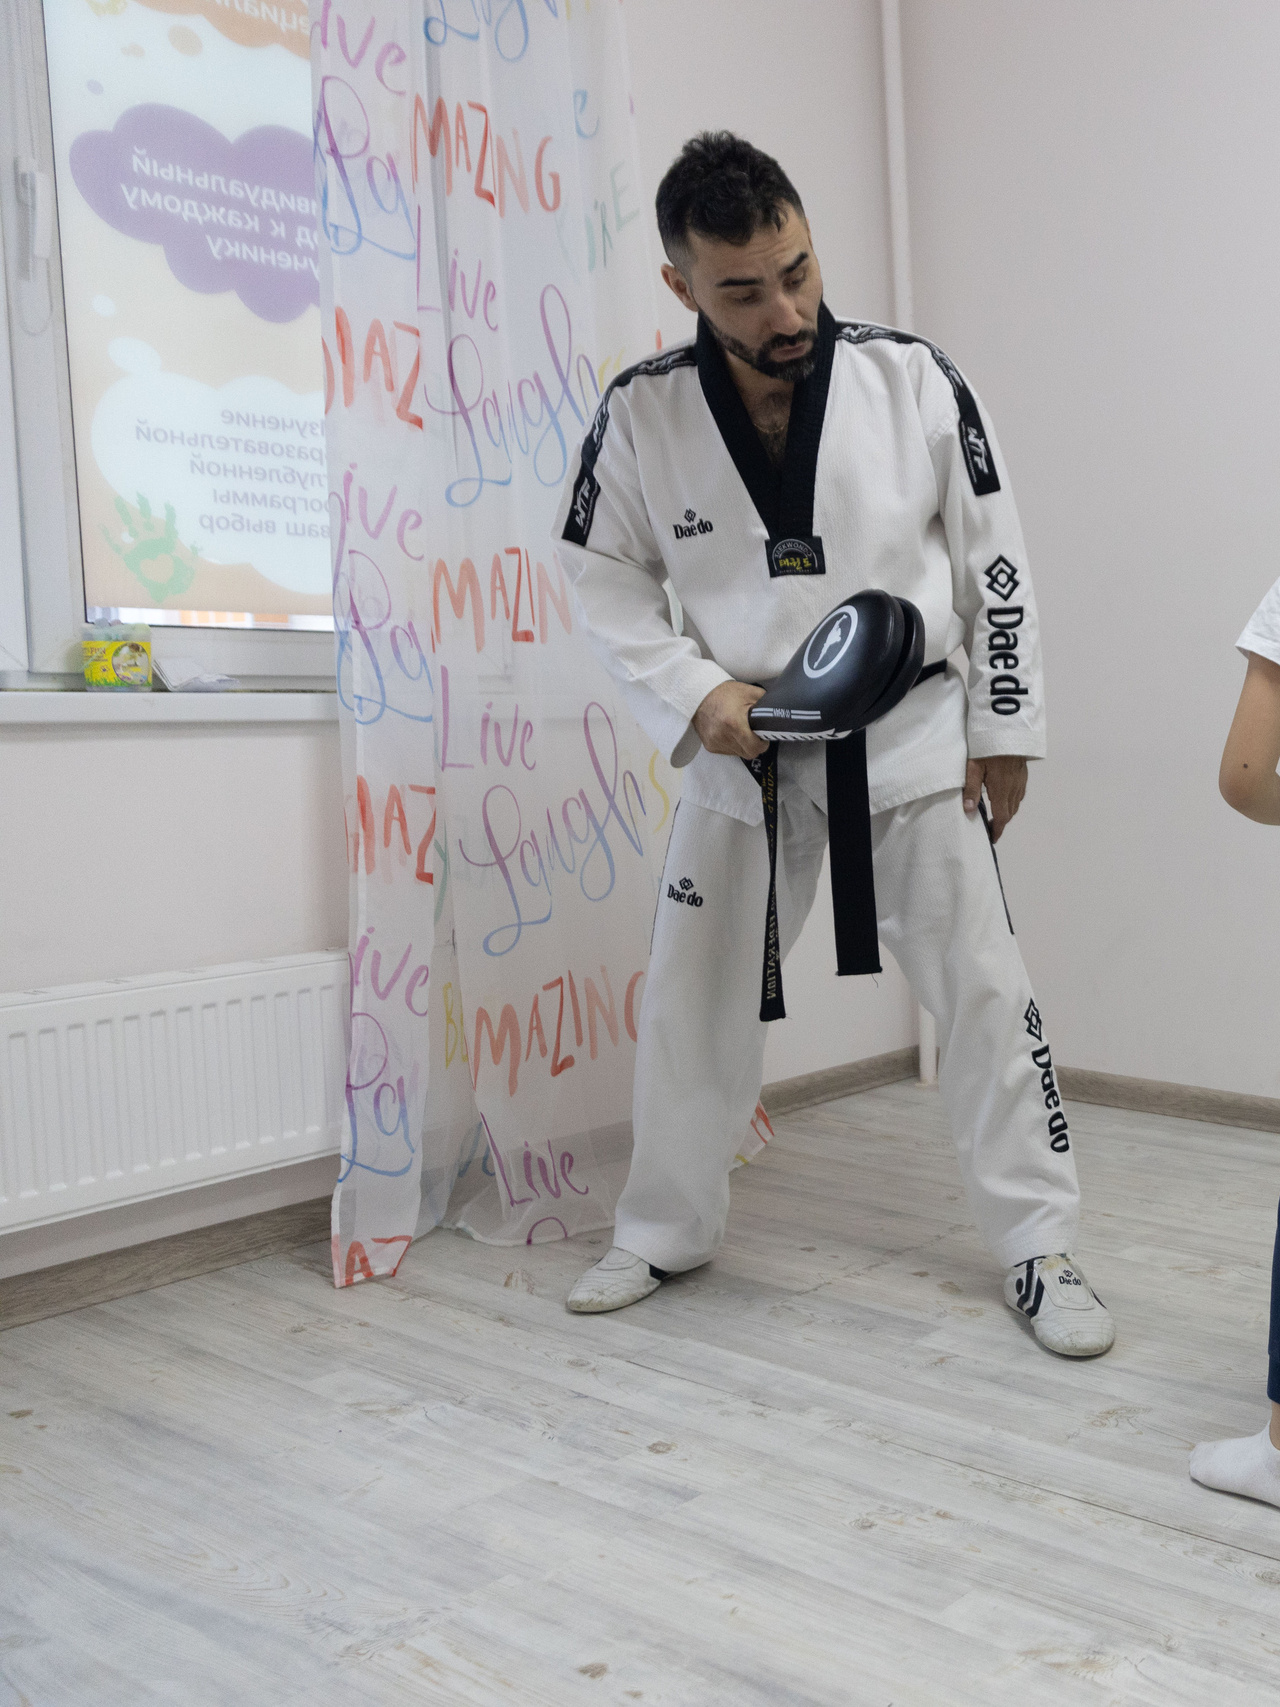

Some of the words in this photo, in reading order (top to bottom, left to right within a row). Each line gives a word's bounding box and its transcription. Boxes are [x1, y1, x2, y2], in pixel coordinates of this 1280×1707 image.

[410, 92, 562, 219] MAZING
[415, 203, 499, 332] Live
[672, 517, 714, 540] Daedo
[986, 605, 1029, 716] Daedo
[438, 665, 537, 772] Live
[666, 883, 704, 908] Daedo
[480, 1111, 589, 1208] Live
